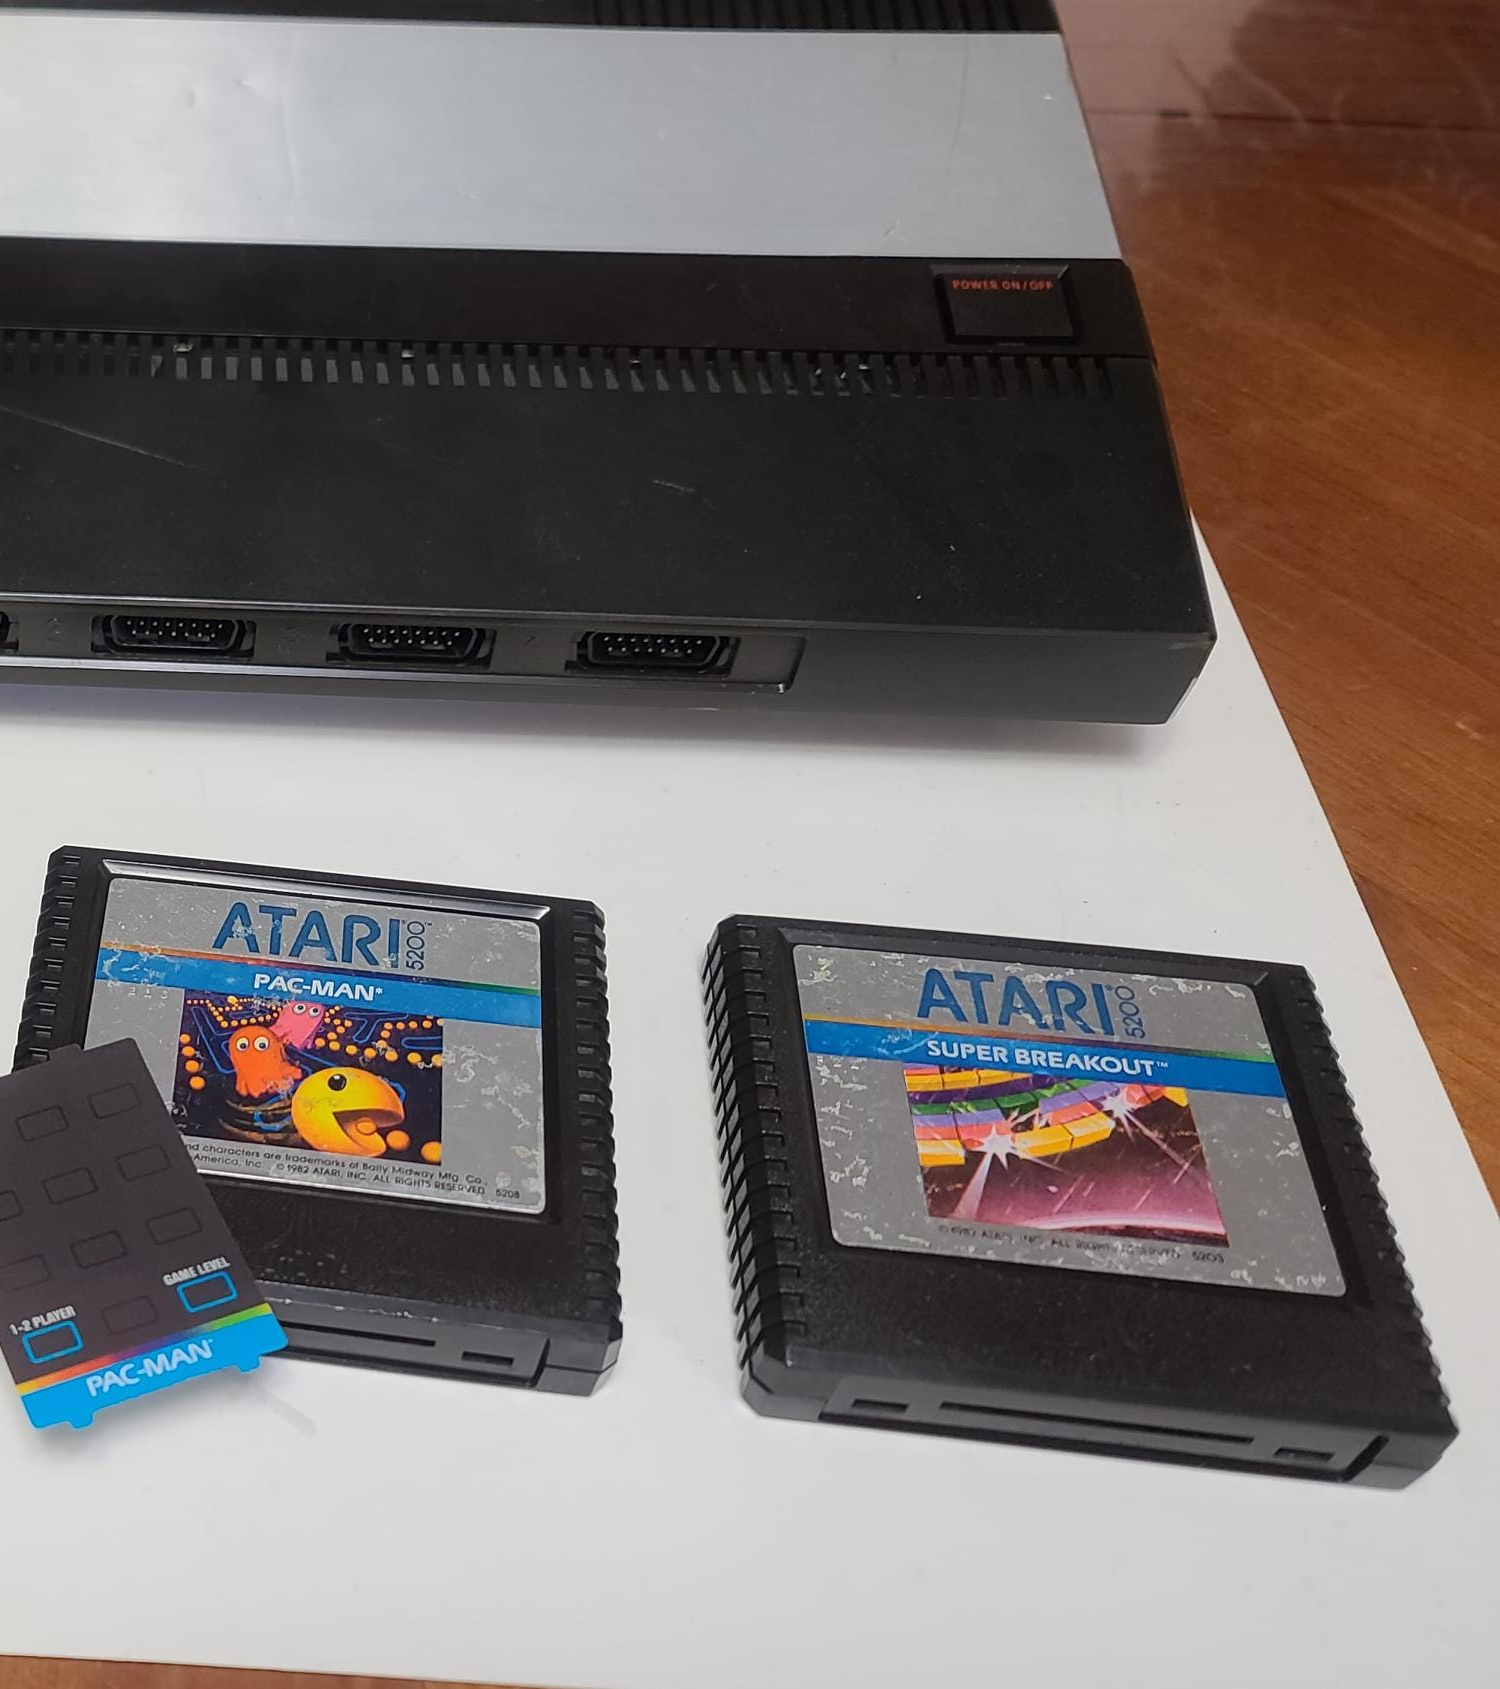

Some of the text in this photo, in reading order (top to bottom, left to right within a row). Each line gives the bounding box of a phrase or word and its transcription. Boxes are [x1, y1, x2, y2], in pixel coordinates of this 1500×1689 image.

[951, 279, 999, 290] POWER
[1114, 985, 1146, 1039] 5200
[927, 1040, 1008, 1063] SUPER
[203, 1145, 260, 1159] characters
[264, 1152, 282, 1161] are
[285, 1154, 346, 1168] trademarks
[362, 1162, 388, 1174] Bally
[392, 1166, 435, 1180] Midway
[287, 1164, 310, 1174] 1982
[373, 1174, 390, 1184] ALL
[395, 1176, 431, 1189] RIGHTS
[434, 1181, 485, 1196] RESERVED
[162, 1257, 231, 1286] GAME LEVEL
[9, 1305, 76, 1335] 1-2 PLAYER
